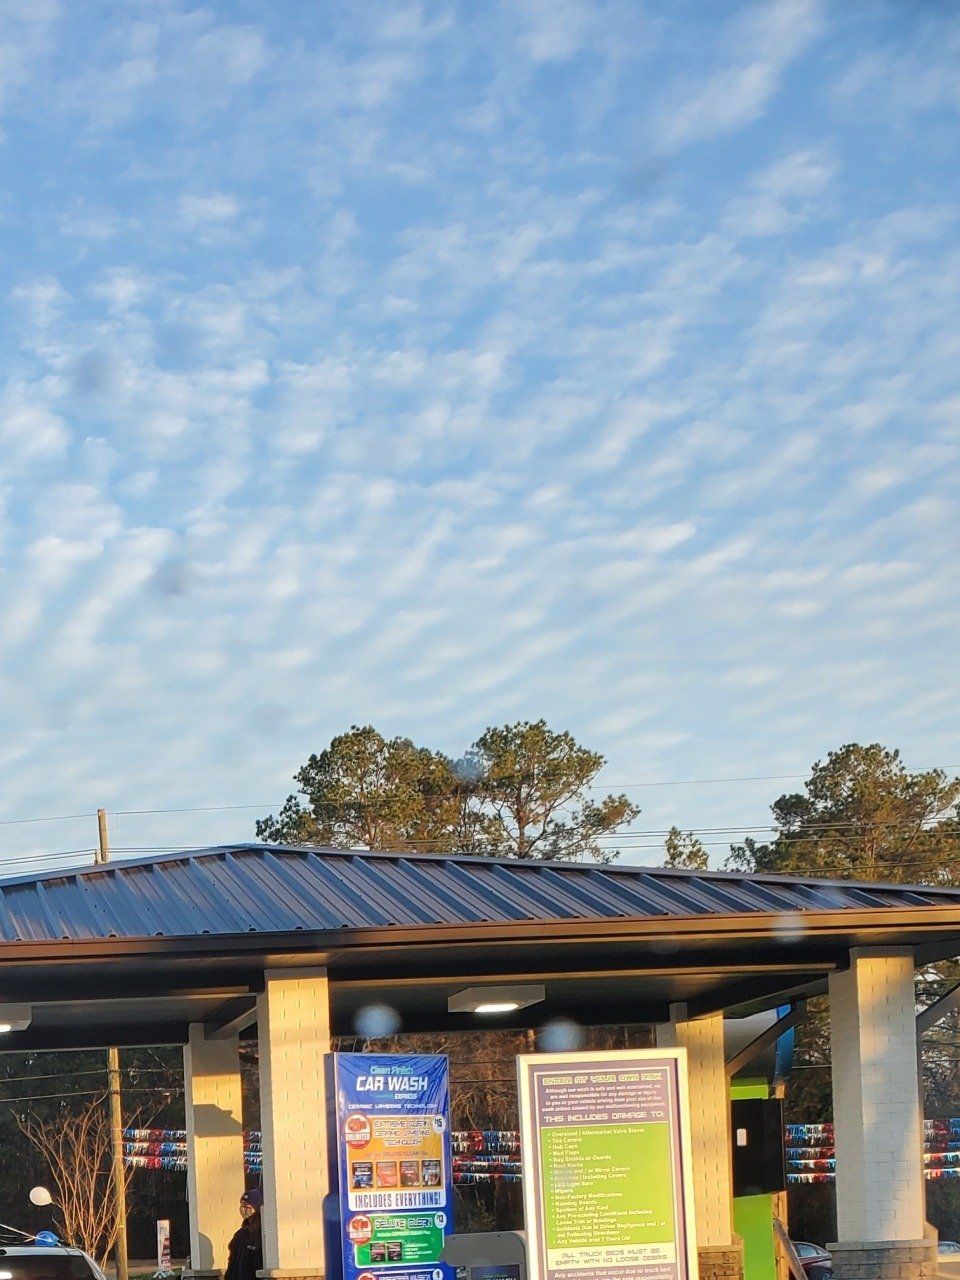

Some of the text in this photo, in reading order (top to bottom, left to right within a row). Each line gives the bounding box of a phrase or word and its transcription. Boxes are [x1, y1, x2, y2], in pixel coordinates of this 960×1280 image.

[356, 1076, 428, 1091] CAR WASH
[544, 1115, 564, 1123] THIS
[567, 1113, 608, 1122] INCLUDES
[611, 1111, 647, 1120] DAMAGE
[355, 1192, 441, 1208] INCLUDES EVERYTHING!
[554, 1272, 566, 1280] Any
